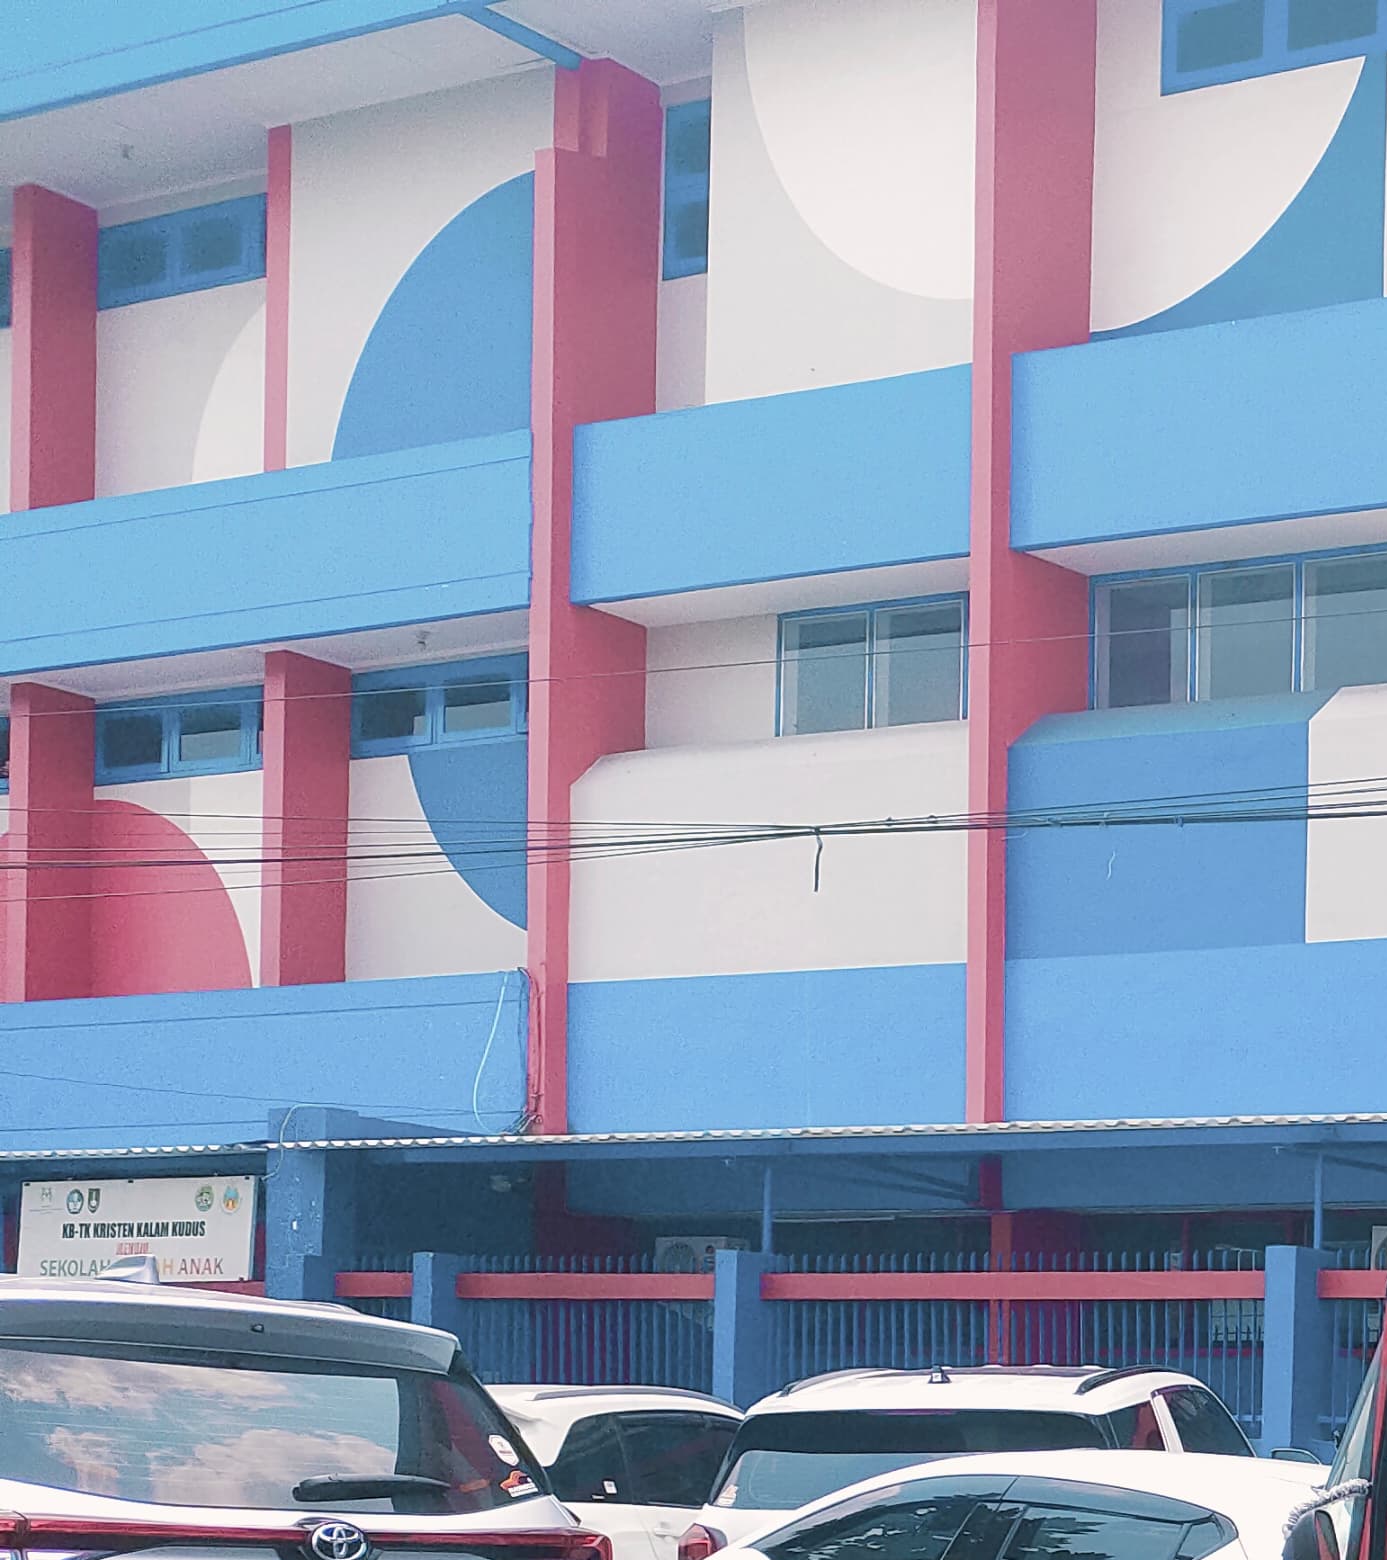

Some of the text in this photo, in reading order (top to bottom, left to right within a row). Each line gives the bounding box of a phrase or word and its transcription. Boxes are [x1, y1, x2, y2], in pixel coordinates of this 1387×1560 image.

[62, 1220, 206, 1239] KB-TK KRISTEN KALAM KUDUS
[177, 1257, 224, 1275] ANAK
